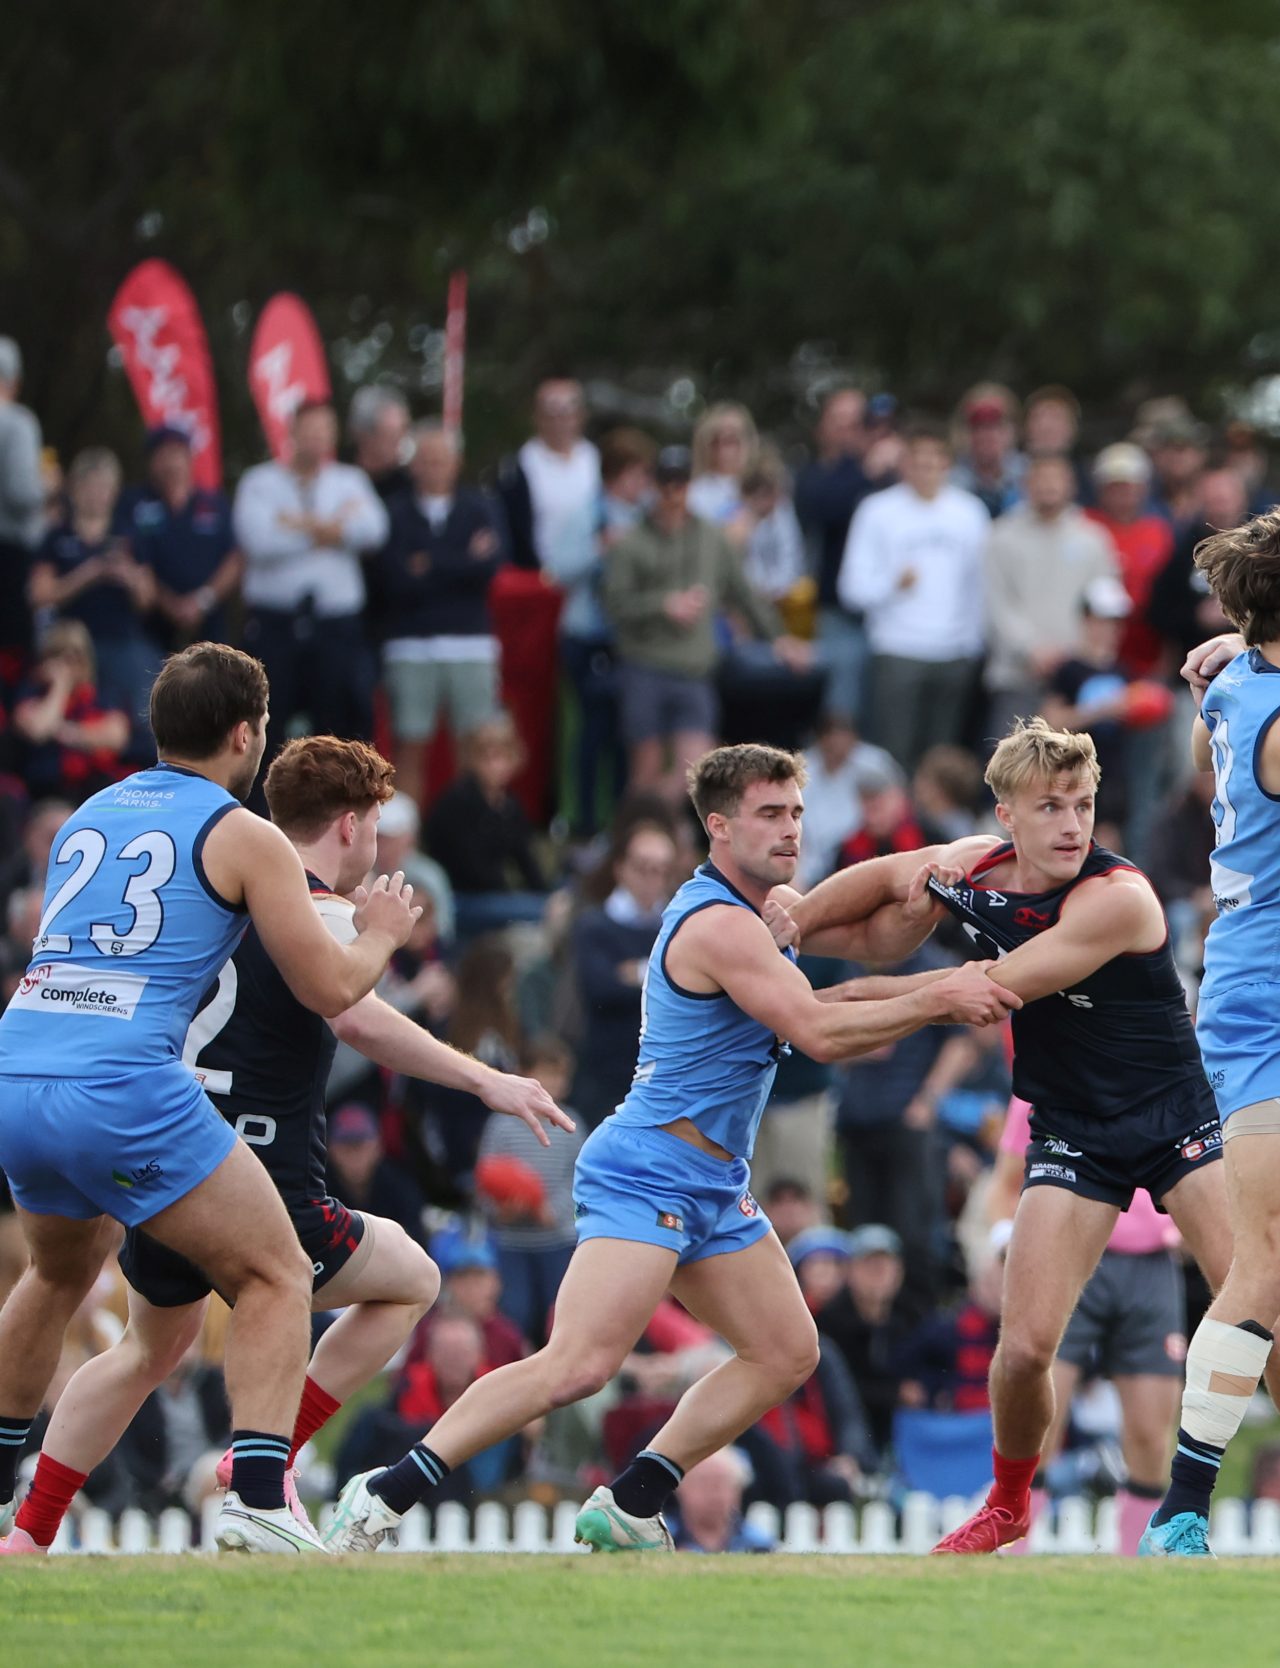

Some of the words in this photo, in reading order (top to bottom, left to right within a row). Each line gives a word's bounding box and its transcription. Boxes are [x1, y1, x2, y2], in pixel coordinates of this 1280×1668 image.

[113, 787, 176, 800] THOMAS
[32, 828, 177, 957] 23
[41, 988, 117, 1006] complete
[76, 1003, 128, 1015] WINDSCREENS
[131, 1159, 161, 1180] LMS
